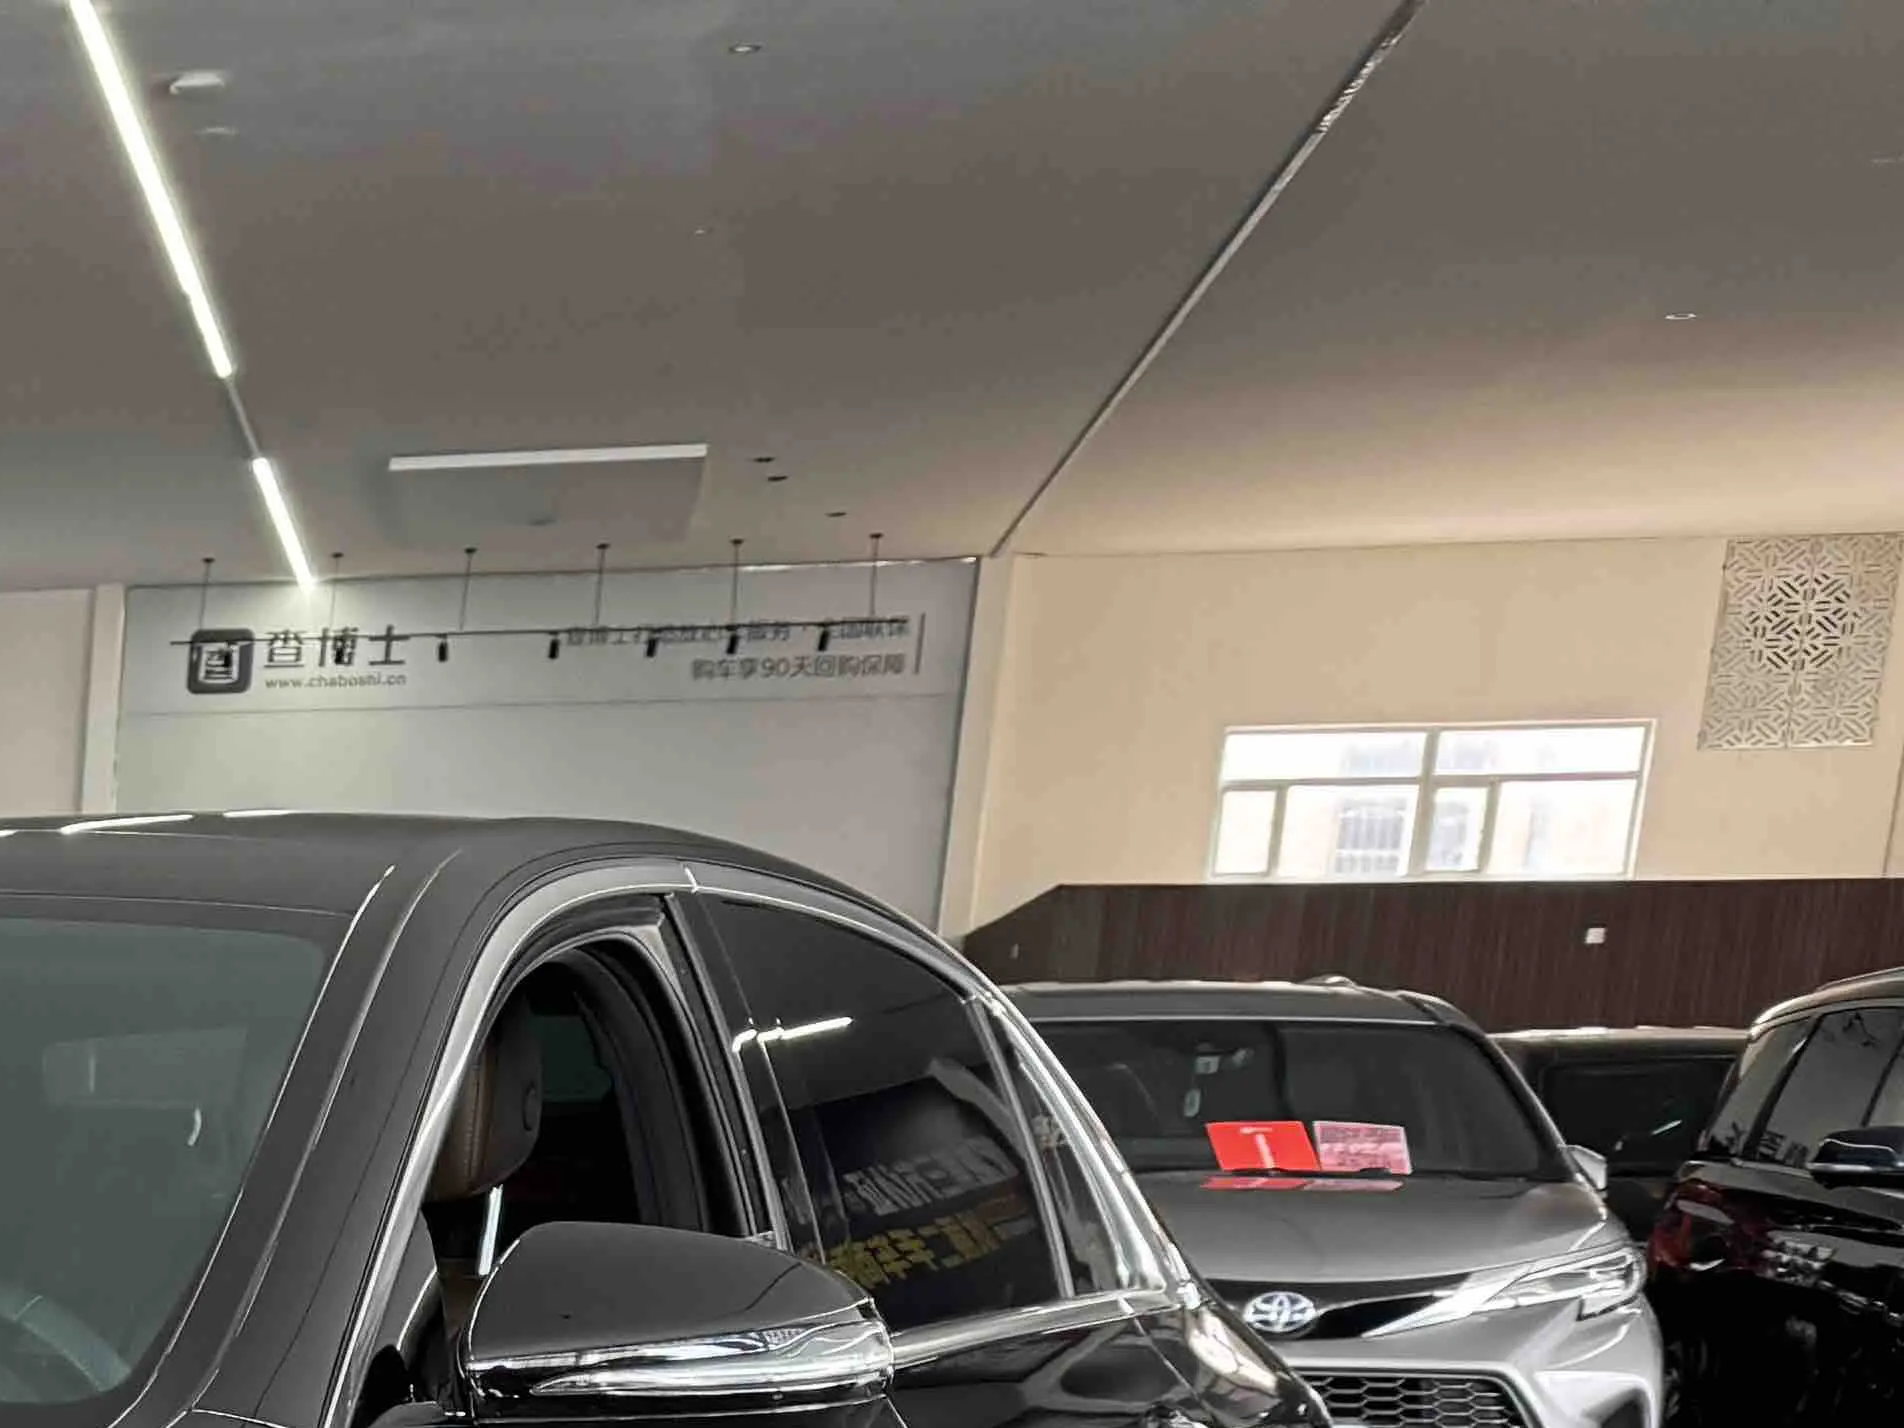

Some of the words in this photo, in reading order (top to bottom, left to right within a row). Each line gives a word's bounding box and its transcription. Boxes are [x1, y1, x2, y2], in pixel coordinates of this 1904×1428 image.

[264, 624, 410, 668] 查博士
[264, 672, 408, 690] www.chaboshi.cn
